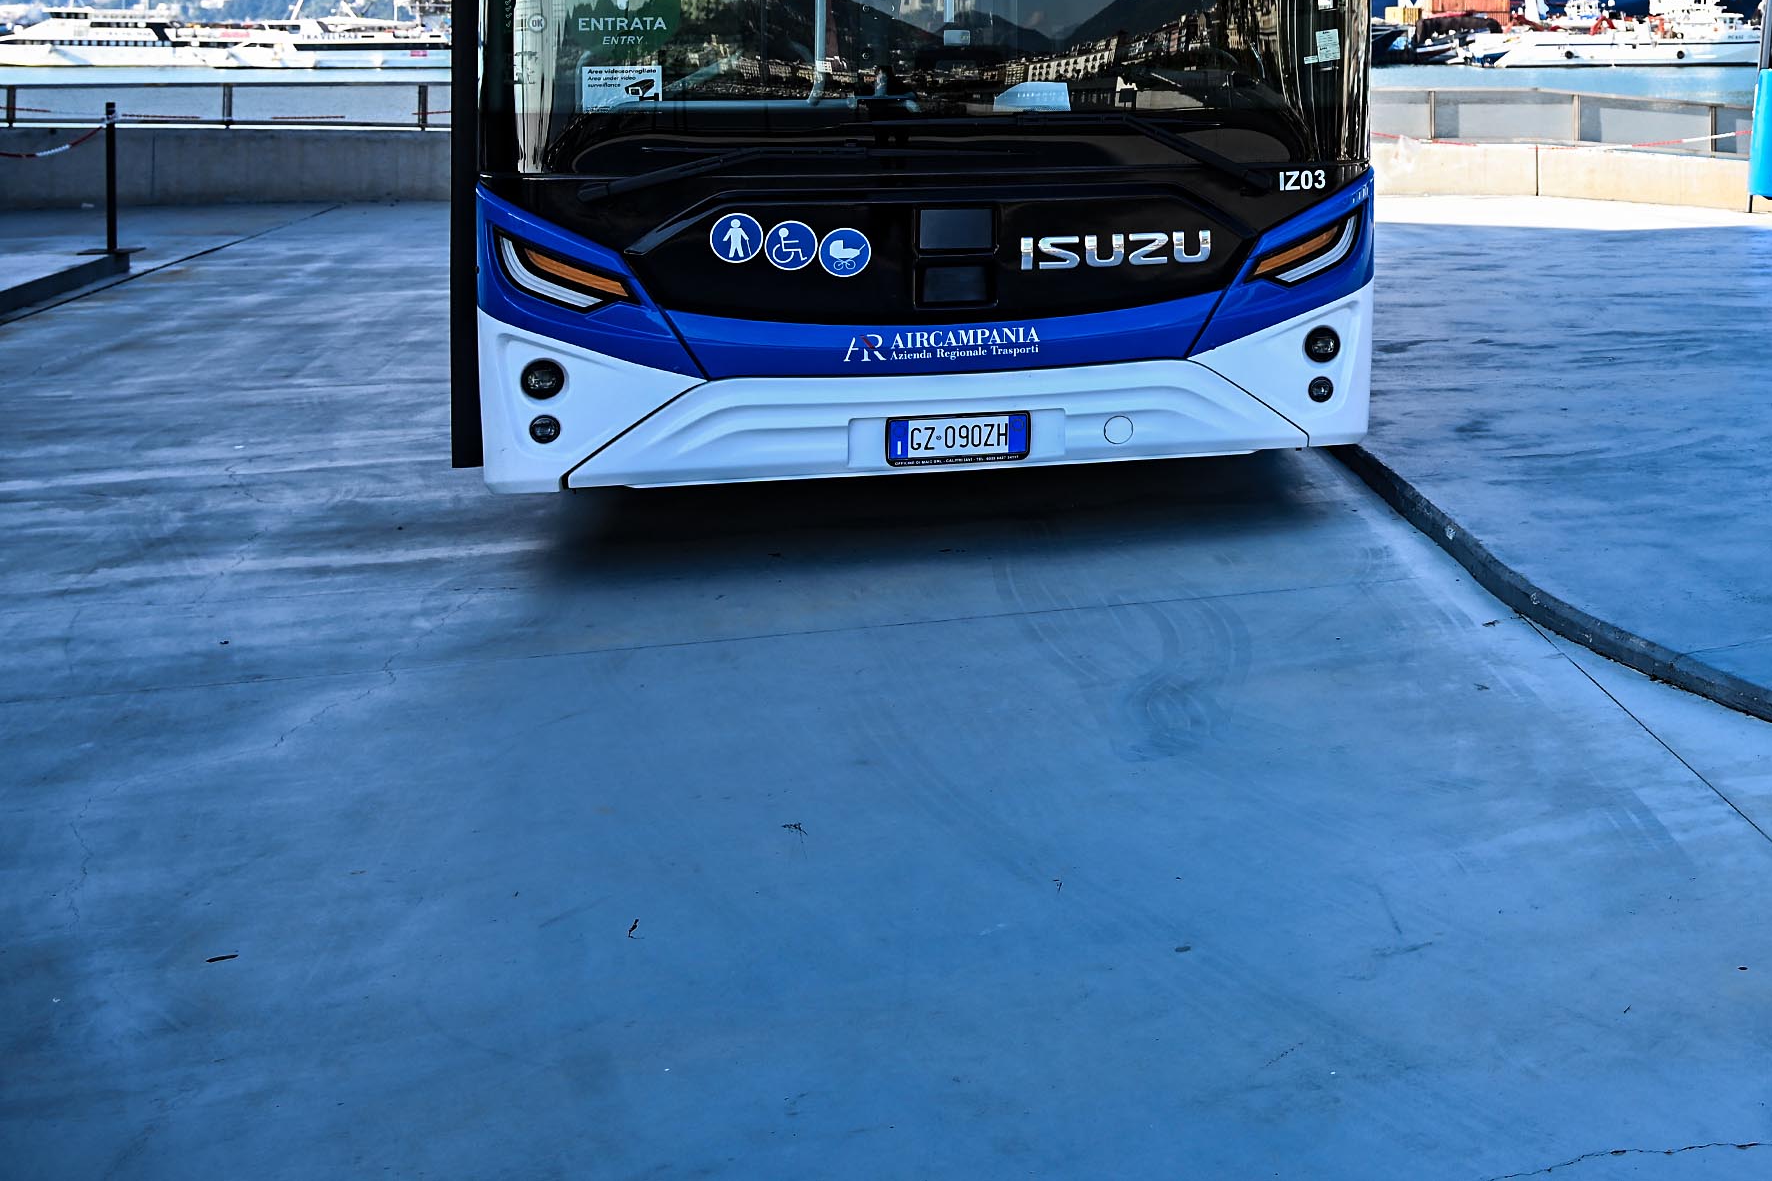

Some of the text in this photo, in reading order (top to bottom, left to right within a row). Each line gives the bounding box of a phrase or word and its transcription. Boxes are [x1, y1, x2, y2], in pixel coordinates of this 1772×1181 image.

[531, 18, 543, 28] OK
[578, 16, 667, 31] ENTRATA
[602, 35, 644, 45] ENTRY
[1279, 169, 1327, 191] IZ03
[1020, 230, 1211, 270] ISUZU
[891, 326, 1041, 349] AIRCAMPANIA
[890, 344, 1039, 361] Azienda Regionale Trasporti
